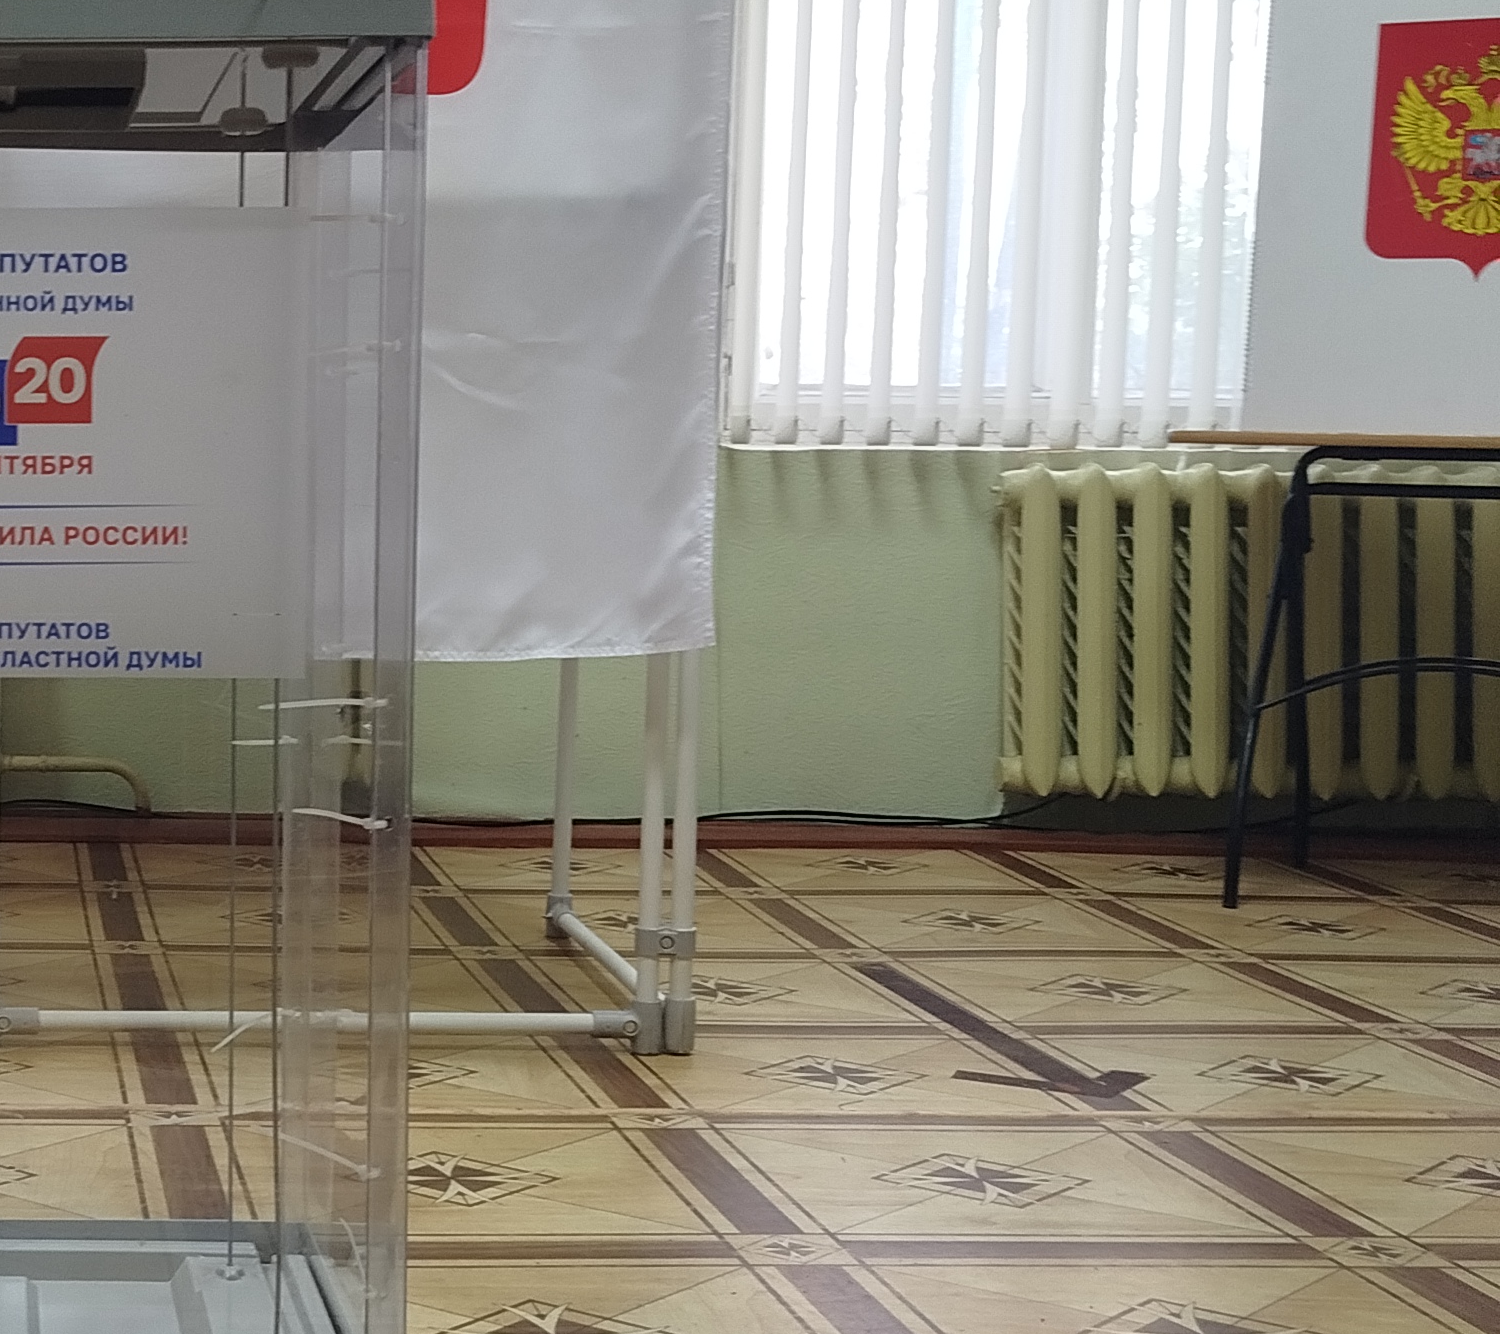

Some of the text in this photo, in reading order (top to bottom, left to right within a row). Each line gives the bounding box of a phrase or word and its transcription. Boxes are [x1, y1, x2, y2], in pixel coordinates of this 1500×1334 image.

[61, 294, 134, 315] ДУМЫ
[13, 356, 87, 405] 20
[63, 525, 189, 546] РОССИИ!
[125, 650, 203, 672] ДУМЫ
